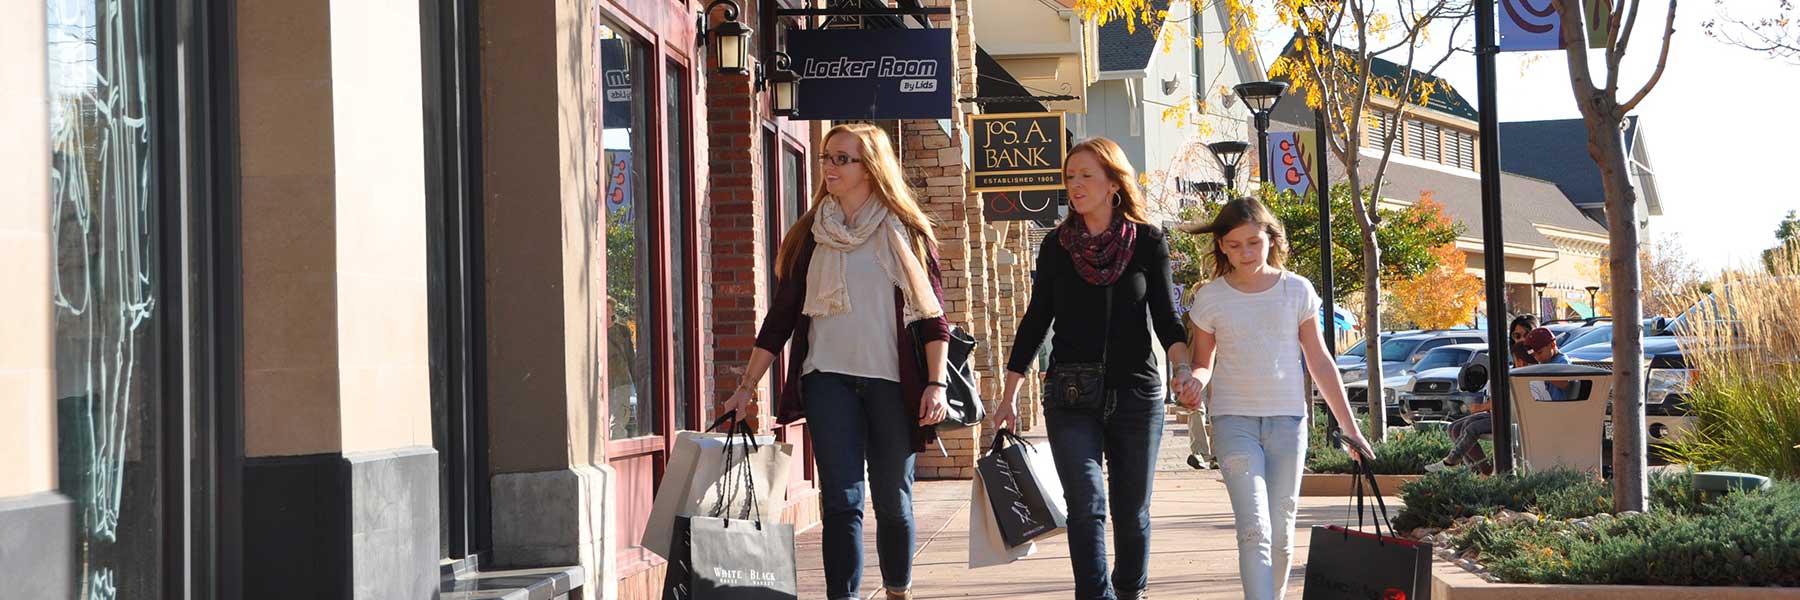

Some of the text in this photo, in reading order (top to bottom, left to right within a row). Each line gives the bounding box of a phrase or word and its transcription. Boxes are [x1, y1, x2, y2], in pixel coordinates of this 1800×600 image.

[803, 56, 938, 79] Locker Room
[903, 80, 934, 91] By Lids
[1023, 120, 1052, 144] A.
[985, 147, 1051, 168] BANK
[983, 176, 1034, 184] ESTABLISHED
[750, 569, 776, 581] BLACK
